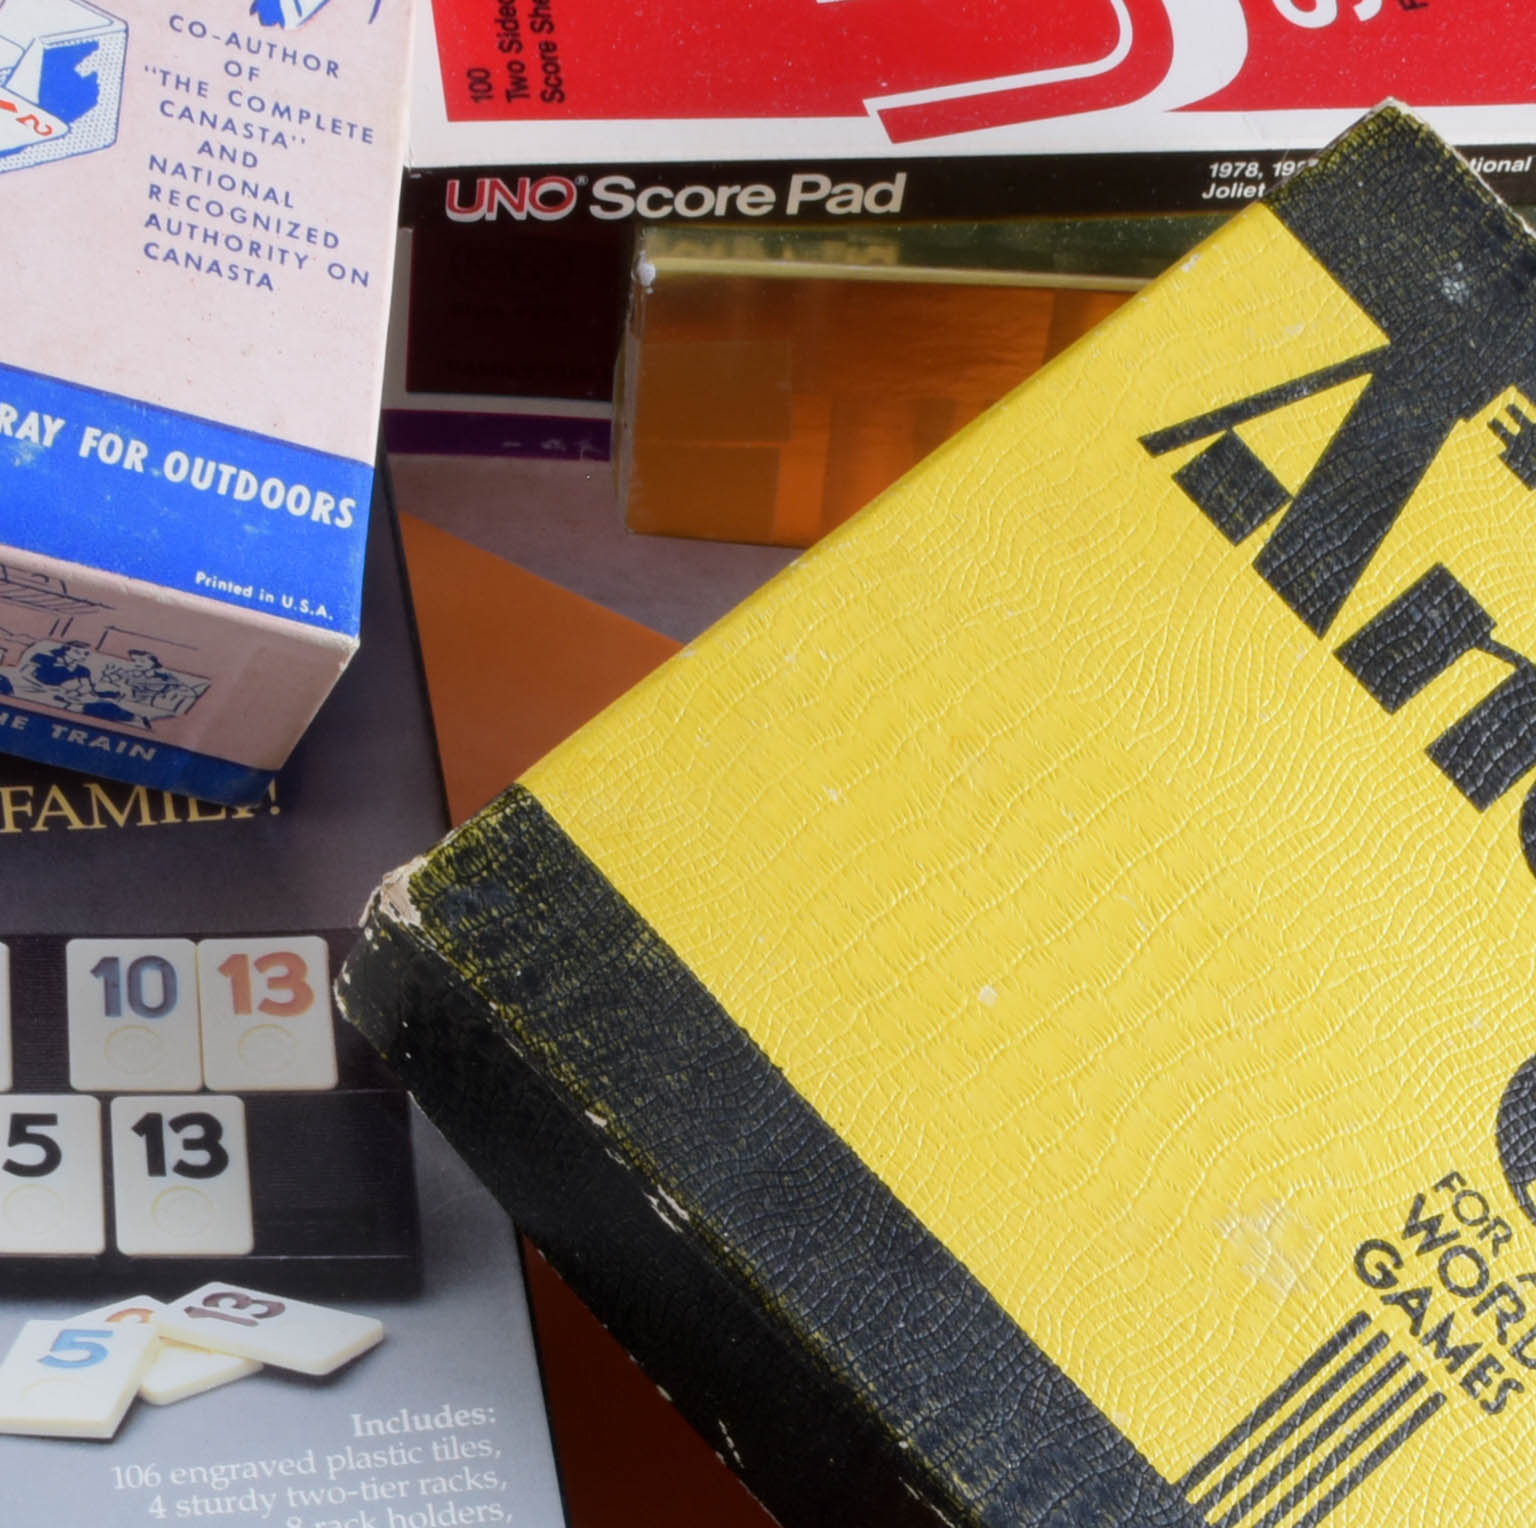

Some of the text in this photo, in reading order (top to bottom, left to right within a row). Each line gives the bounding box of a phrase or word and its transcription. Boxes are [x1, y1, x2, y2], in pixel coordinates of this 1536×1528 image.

[169, 14, 340, 79] CO-AUTHOR
[224, 59, 262, 83] OF
[539, 40, 566, 104] Score
[467, 67, 494, 104] 100
[505, 60, 531, 104] Two
[228, 89, 375, 145] COMPLETE
[149, 154, 296, 209] NATIONAL
[197, 140, 260, 169] AND
[1208, 160, 1265, 180] 1978,
[149, 184, 340, 250] RECOGNIZED
[445, 172, 907, 222] UNO Score Pad
[144, 212, 370, 288] AUTHORITY ON
[144, 242, 275, 292] CANASTA
[79, 427, 146, 473] FOR
[164, 450, 356, 530] OUTDOORS
[195, 570, 334, 621] Printed in U.S.A.
[49, 723, 159, 763] TRAIN
[90, 955, 178, 1018] 10
[218, 951, 315, 1017] 13
[1434, 1170, 1514, 1256] FOR
[1353, 1237, 1525, 1417] GAMES
[351, 1404, 497, 1440] Includes:
[109, 1433, 502, 1491] 106 engraved plastic tiles,
[148, 1467, 508, 1520] 4 sturdy two-tier racks,
